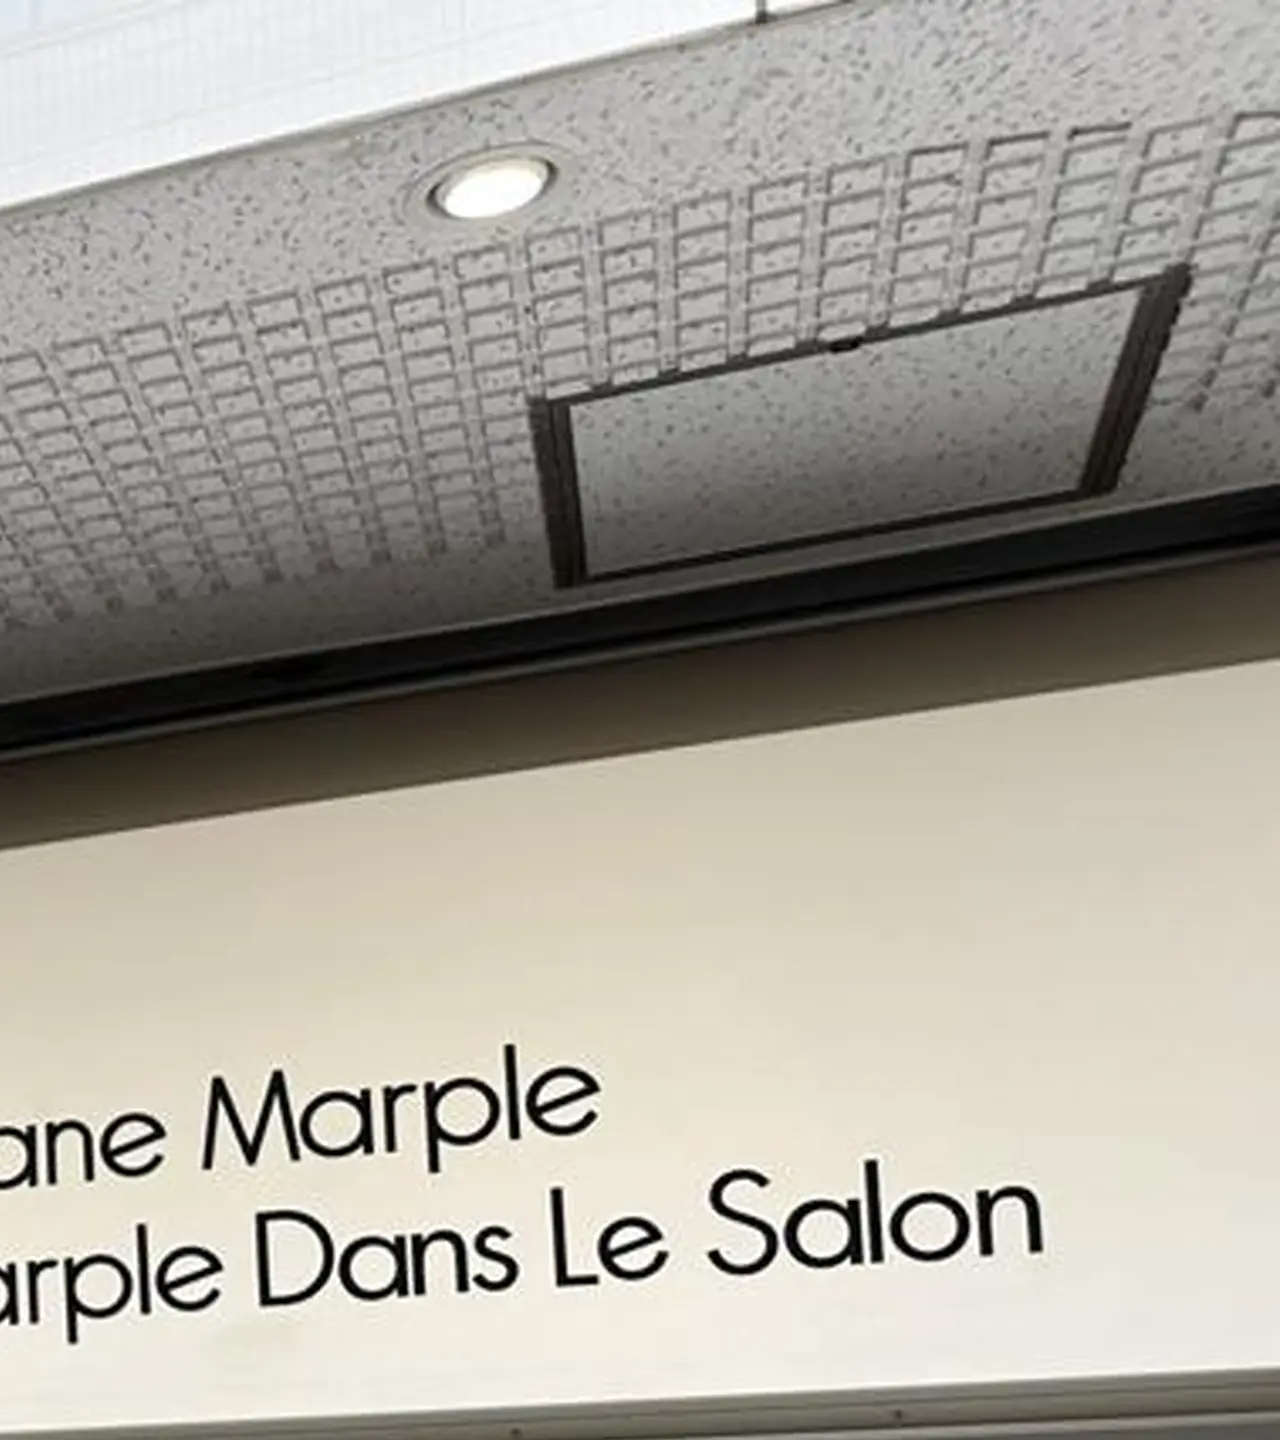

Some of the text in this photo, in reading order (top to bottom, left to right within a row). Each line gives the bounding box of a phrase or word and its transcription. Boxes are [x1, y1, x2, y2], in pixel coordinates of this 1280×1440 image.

[200, 1041, 603, 1175] Marple
[254, 1209, 520, 1308] Dans
[549, 1186, 670, 1288] Le
[706, 1158, 1044, 1277] Salon
